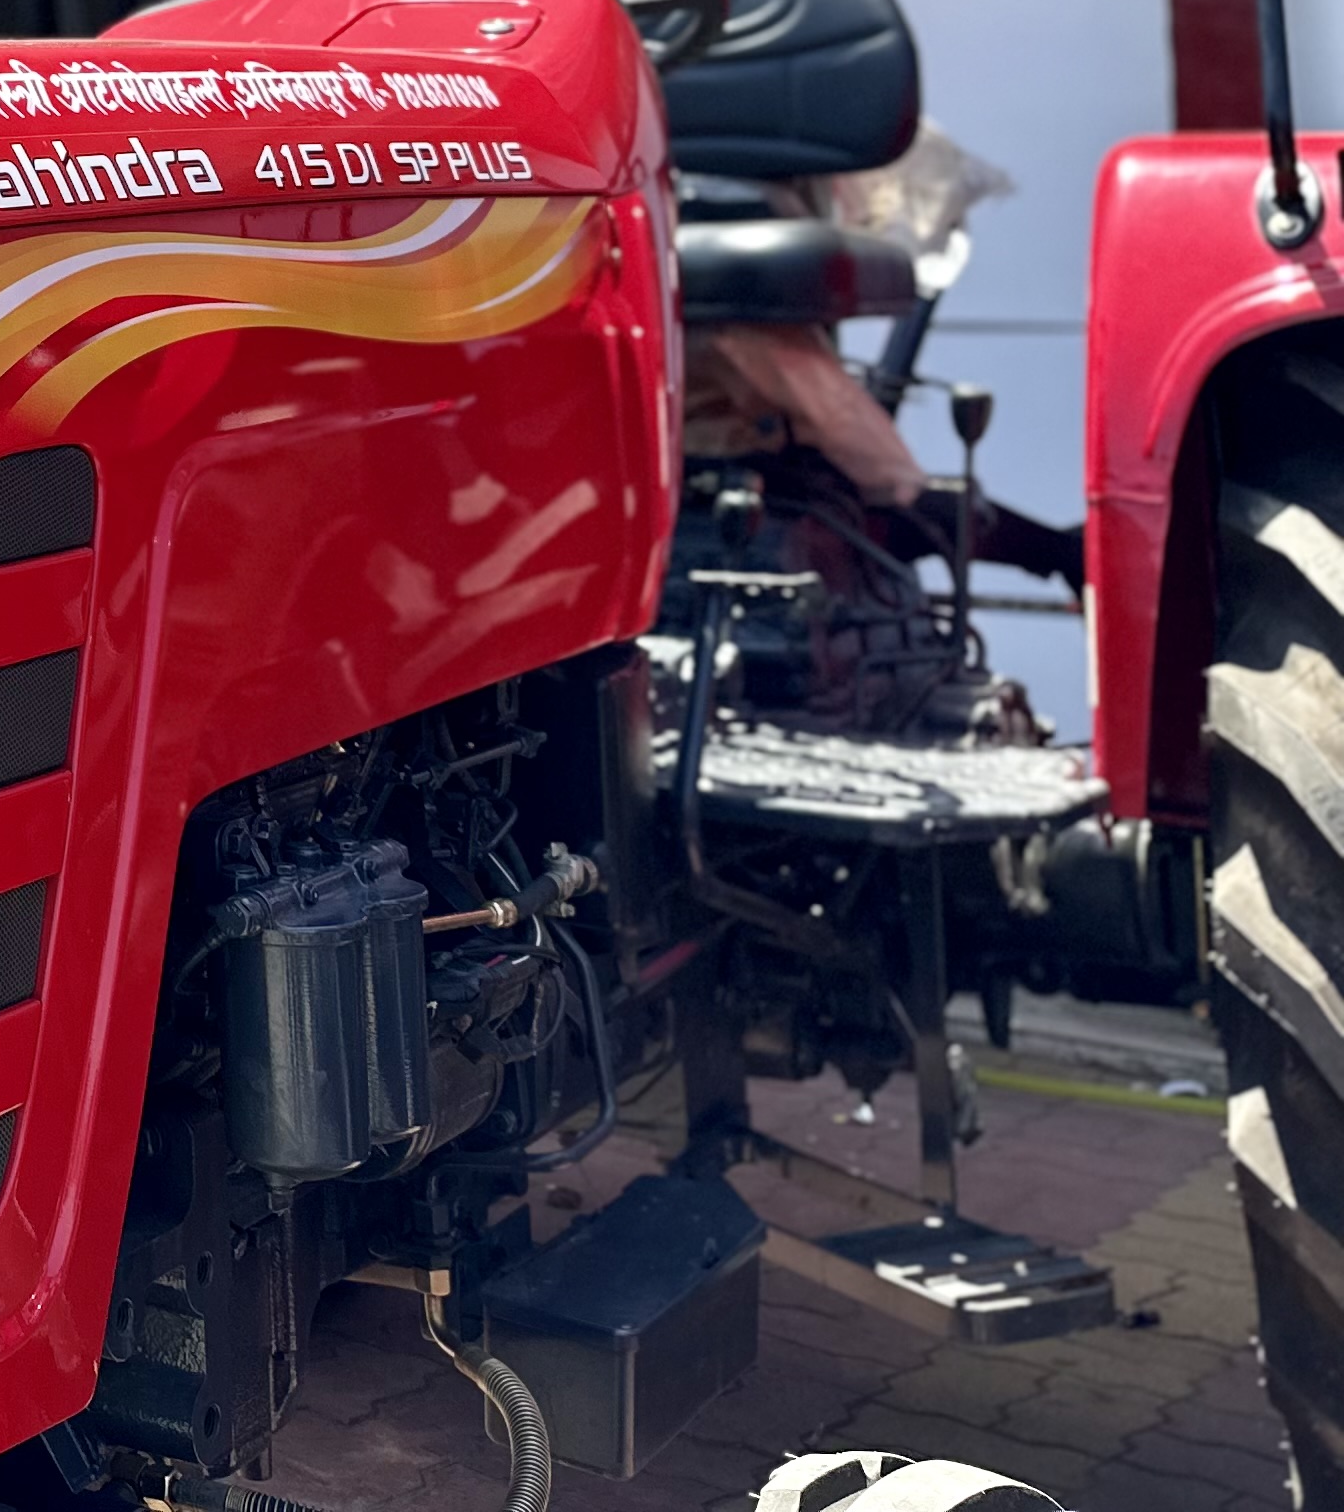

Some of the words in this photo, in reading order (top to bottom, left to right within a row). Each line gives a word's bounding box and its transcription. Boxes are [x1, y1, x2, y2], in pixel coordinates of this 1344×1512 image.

[254, 142, 337, 188] 415
[334, 142, 384, 185] DI
[388, 142, 440, 184] SP
[441, 141, 534, 183] PLUS
